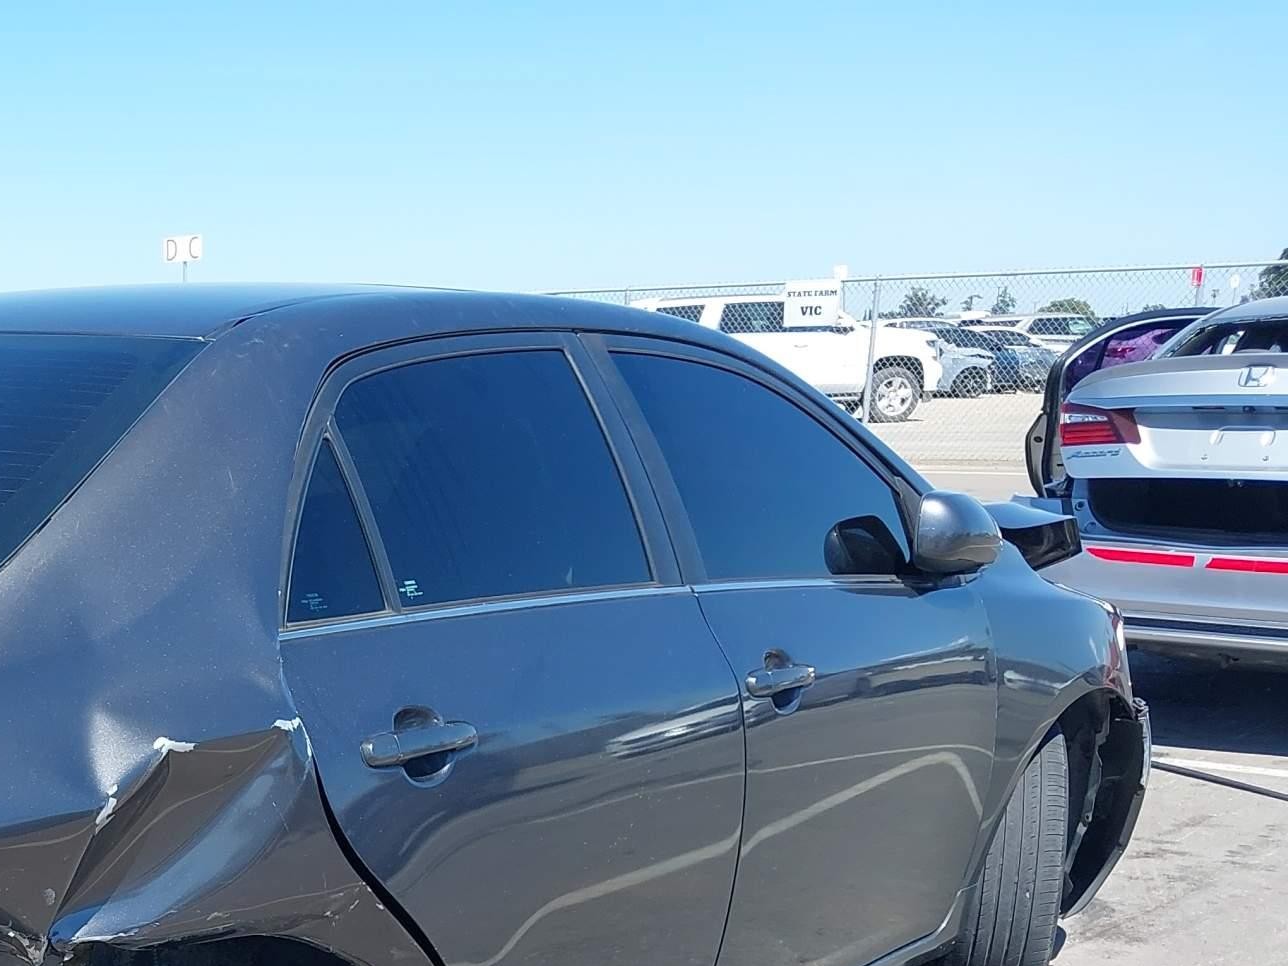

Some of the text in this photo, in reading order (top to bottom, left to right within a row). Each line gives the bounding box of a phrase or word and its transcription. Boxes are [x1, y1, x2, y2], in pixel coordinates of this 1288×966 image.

[166, 236, 200, 261] D C
[787, 289, 838, 298] STATE FARM
[800, 305, 823, 316] VIC
